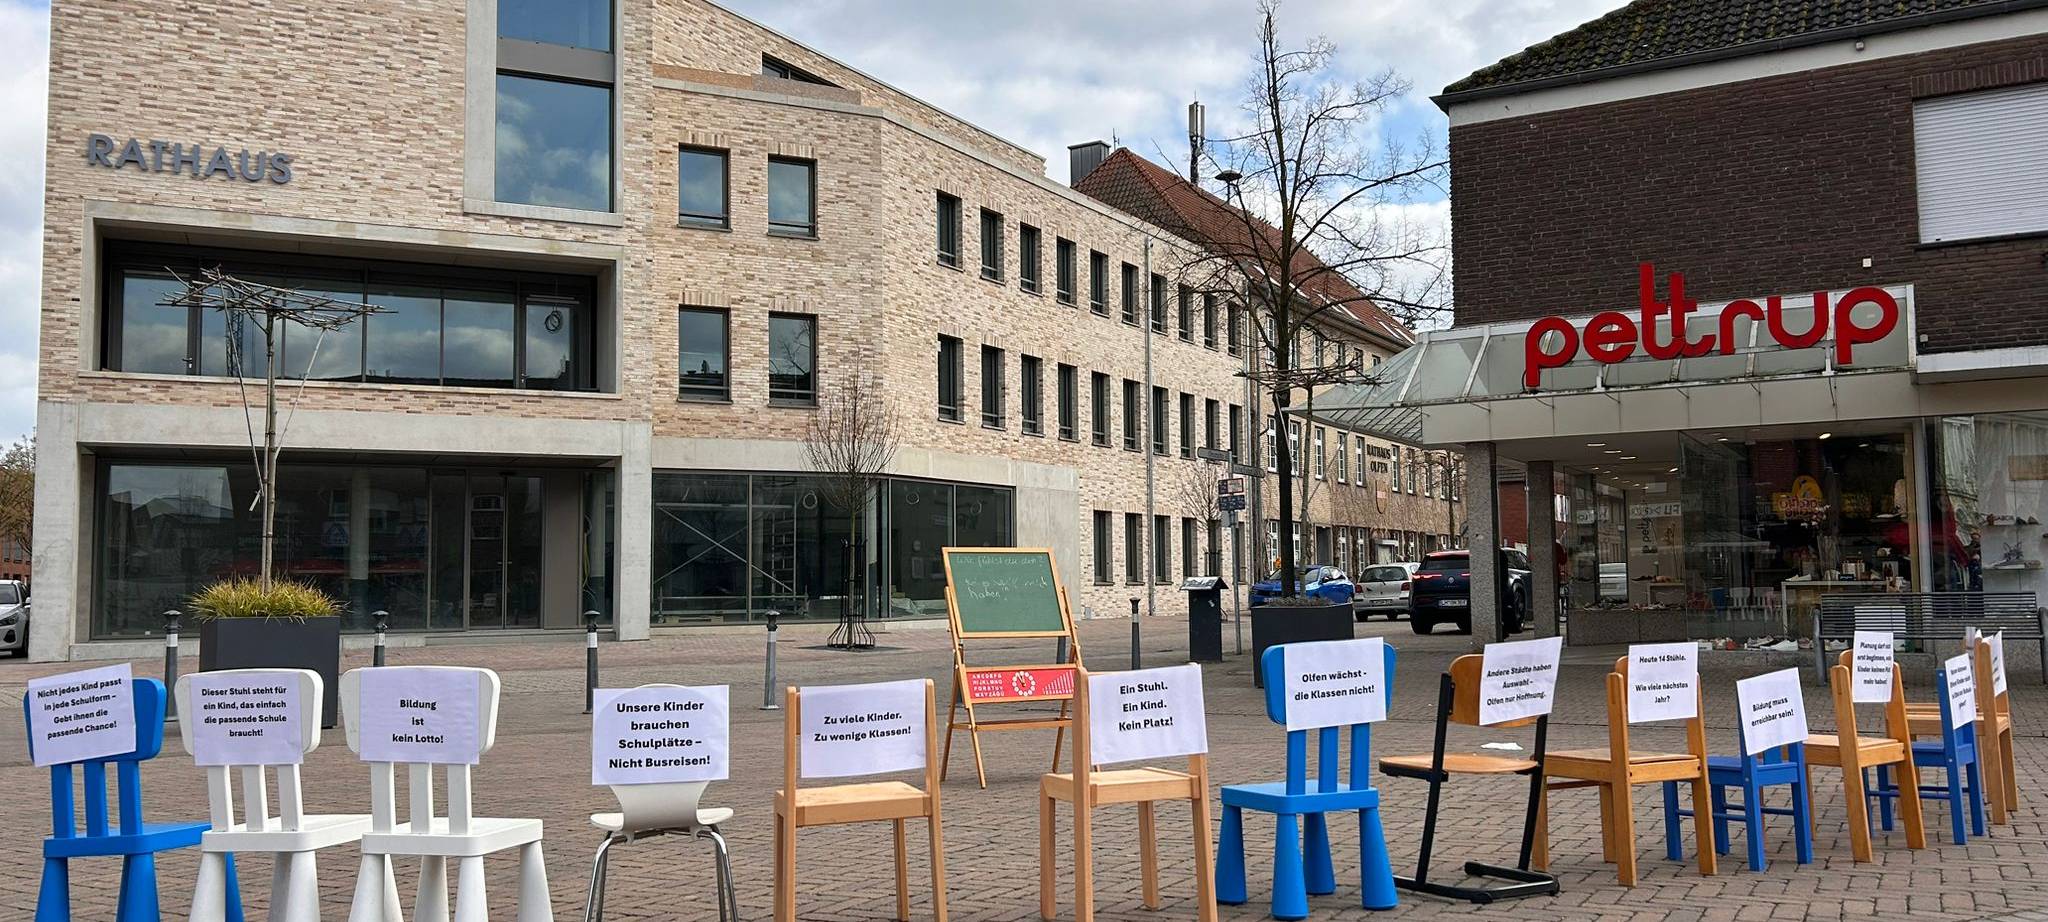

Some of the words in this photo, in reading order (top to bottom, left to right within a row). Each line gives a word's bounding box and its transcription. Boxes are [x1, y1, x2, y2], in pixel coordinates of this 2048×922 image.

[87, 134, 291, 184] RATHAUS
[1526, 263, 1898, 386] pettrup
[1366, 444, 1391, 459] RATHAUS
[1370, 461, 1388, 473] OLFEN
[1666, 654, 1686, 662] Stühle.
[1302, 673, 1327, 683] Olfen
[1329, 670, 1362, 680] wächst
[1487, 669, 1510, 678] Andere
[1511, 666, 1532, 675] Städte
[37, 689, 58, 698] Nicht
[59, 686, 80, 696] jedes
[81, 681, 98, 691] Kind
[100, 678, 122, 689] passt
[229, 687, 251, 695] Stuhl
[252, 687, 273, 695] steht
[274, 686, 287, 694] für
[1120, 685, 1135, 695] Ein
[1137, 681, 1168, 692] Stuhl.
[1502, 679, 1529, 689] Auswahl
[1635, 684, 1647, 692] Wie
[1648, 683, 1661, 691] viele
[1662, 682, 1688, 690] nächstes
[1294, 692, 1309, 701] die
[1311, 690, 1347, 699] Klassen
[1349, 685, 1374, 695] nicht!
[1487, 698, 1504, 706] Olfen
[1516, 692, 1546, 701] Hoffnung.
[1655, 695, 1670, 703] Jahr?
[52, 701, 70, 711] jede
[70, 694, 110, 706] Schulform
[217, 702, 238, 710] Kind,
[240, 701, 255, 709] das
[256, 700, 286, 708] einfach
[400, 699, 437, 711] Bildung
[617, 703, 661, 713] Unsere
[664, 701, 704, 711] Kinder
[1123, 703, 1138, 712] Ein
[1140, 699, 1167, 710] Kind.
[1753, 701, 1772, 712] Bildung
[1772, 697, 1788, 706] muss
[54, 715, 72, 724] Gebt
[73, 712, 95, 720] ihnen
[96, 709, 108, 717] die
[218, 715, 257, 725] passende
[258, 714, 287, 722] Schule
[412, 717, 424, 726] ist
[824, 716, 837, 725] Zu
[839, 715, 865, 724] viele
[867, 712, 902, 722] Kinder.
[1751, 714, 1777, 727] erreichbar
[1778, 709, 1794, 718] sein!
[47, 727, 84, 740] passende
[85, 720, 117, 732] Chance!
[631, 720, 689, 730] brauchen
[1119, 721, 1141, 731] Kein
[1144, 716, 1173, 728] Platz!
[229, 729, 263, 737] braucht!
[392, 733, 413, 742] kein
[415, 734, 444, 743] Lotto!
[814, 733, 827, 741] Zu
[829, 731, 867, 741] wenige
[869, 726, 911, 738] Klassen!
[619, 738, 693, 750] Schulplätze
[609, 758, 642, 768] Nicht
[646, 755, 710, 767] Busreisen!
